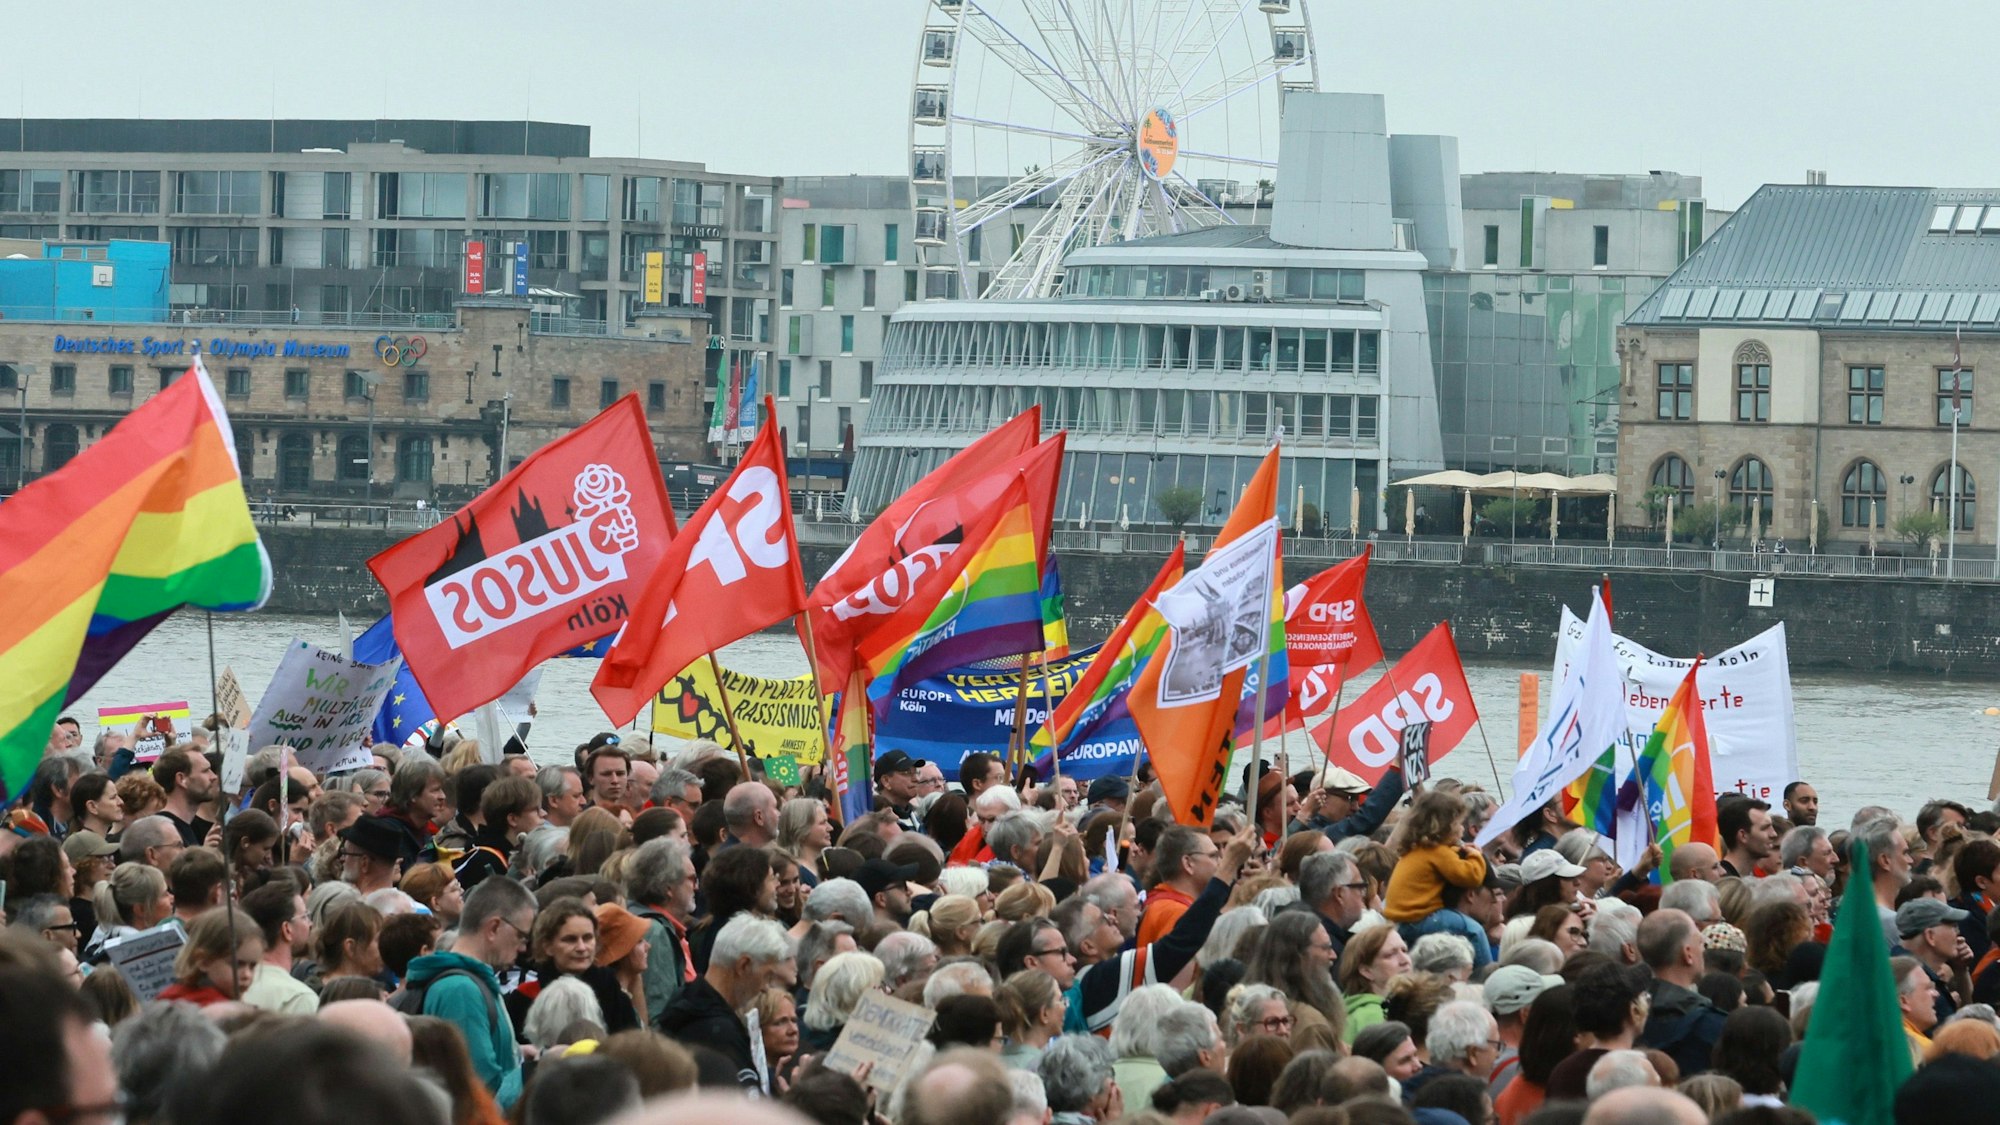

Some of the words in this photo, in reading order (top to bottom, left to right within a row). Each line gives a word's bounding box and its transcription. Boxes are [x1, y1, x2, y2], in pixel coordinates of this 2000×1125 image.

[53, 335, 134, 353] Deutsches
[141, 336, 184, 358] Sport
[210, 338, 277, 360] Olympia
[283, 340, 351, 358] Museum
[315, 650, 344, 664] KEINE
[1613, 641, 1636, 658] for
[306, 668, 350, 697] WIR
[901, 688, 953, 703] EUROPE
[900, 699, 927, 713] Köln
[273, 709, 307, 724] AUCH
[733, 699, 822, 731] RASSISMUS!
[273, 735, 313, 752] UND
[780, 738, 807, 751] AMNESTY
[1404, 722, 1426, 755] FCK
[1404, 749, 1425, 789] NZS
